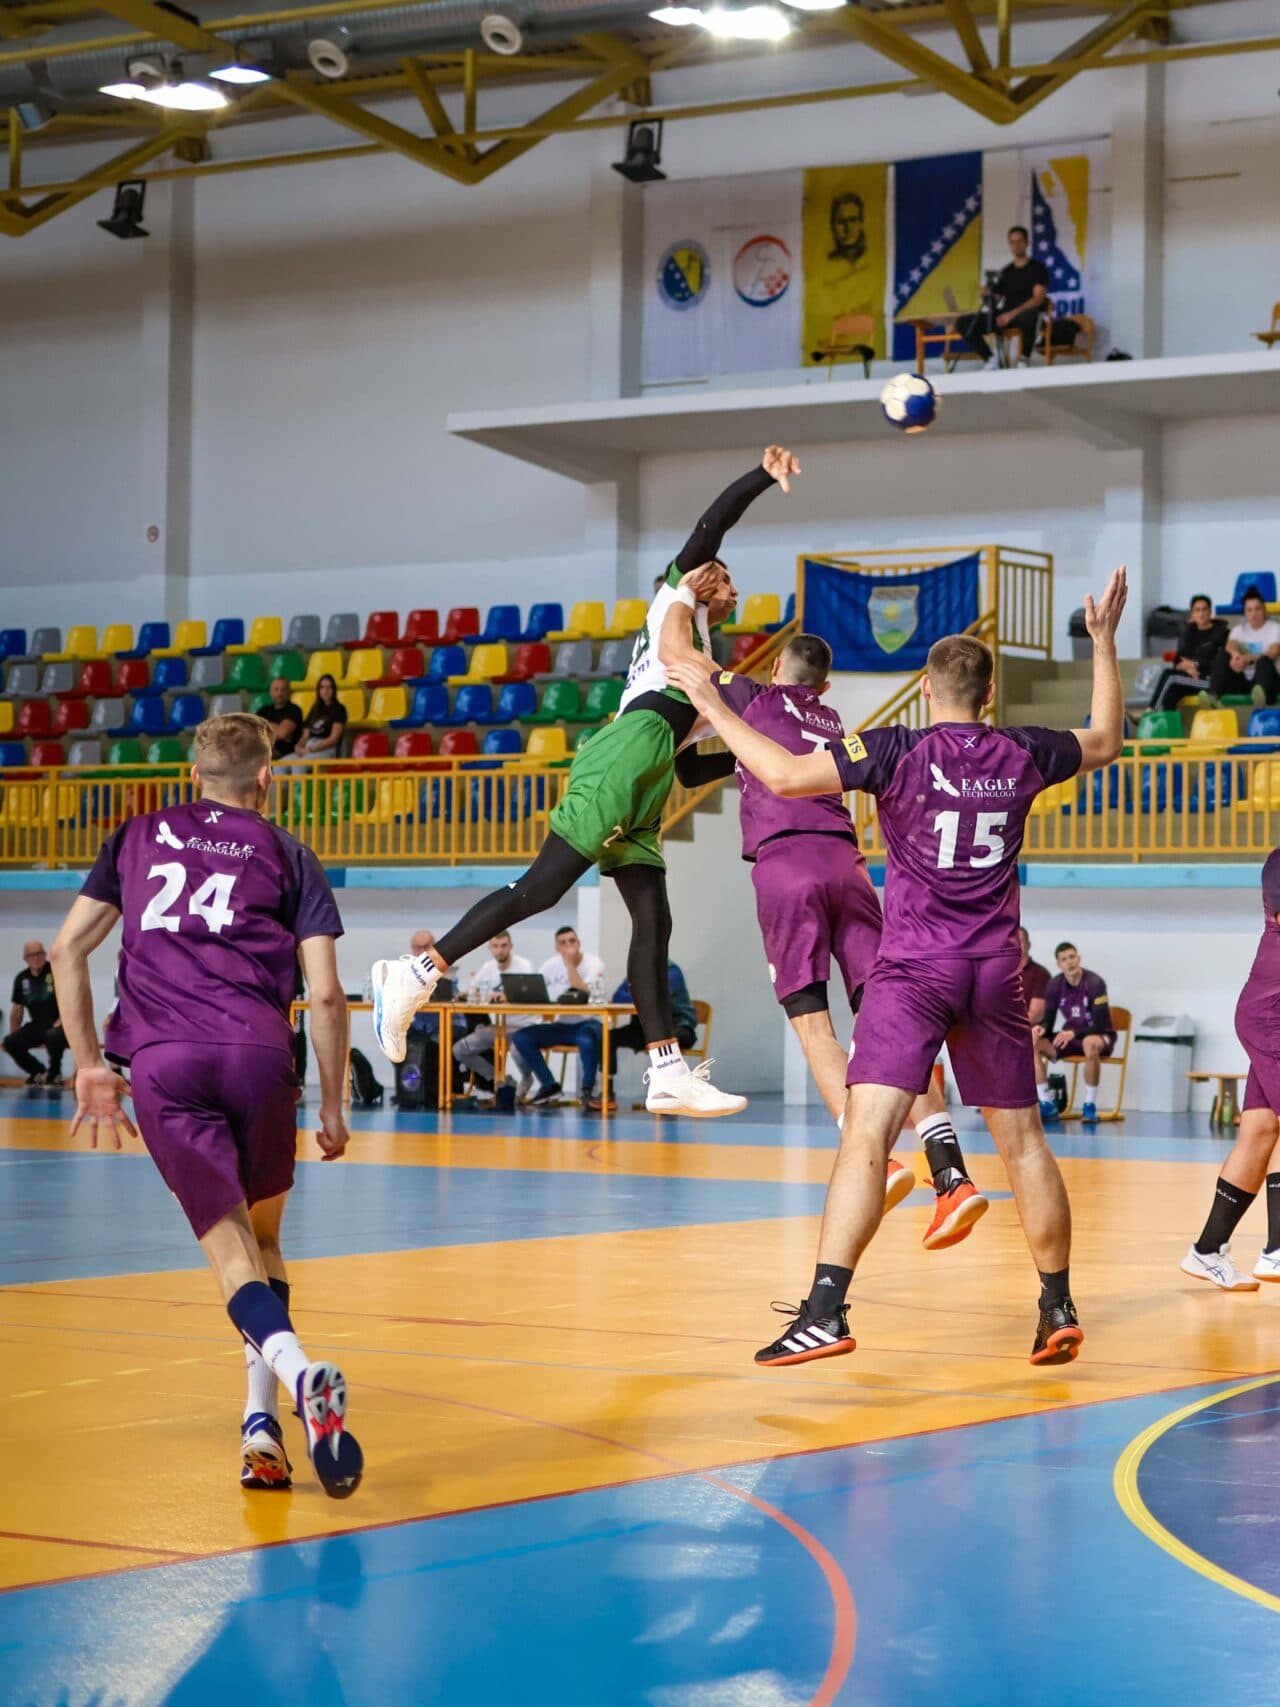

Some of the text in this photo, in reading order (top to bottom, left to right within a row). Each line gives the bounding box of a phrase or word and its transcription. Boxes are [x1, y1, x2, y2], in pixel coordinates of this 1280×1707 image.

[961, 778, 1017, 791] EAGLE
[961, 790, 1017, 798] TECHNOLOGY
[187, 836, 255, 854] EAGLE
[933, 810, 1009, 869] 15
[186, 842, 252, 861] TECHNOLOGY
[140, 862, 237, 934] 24
